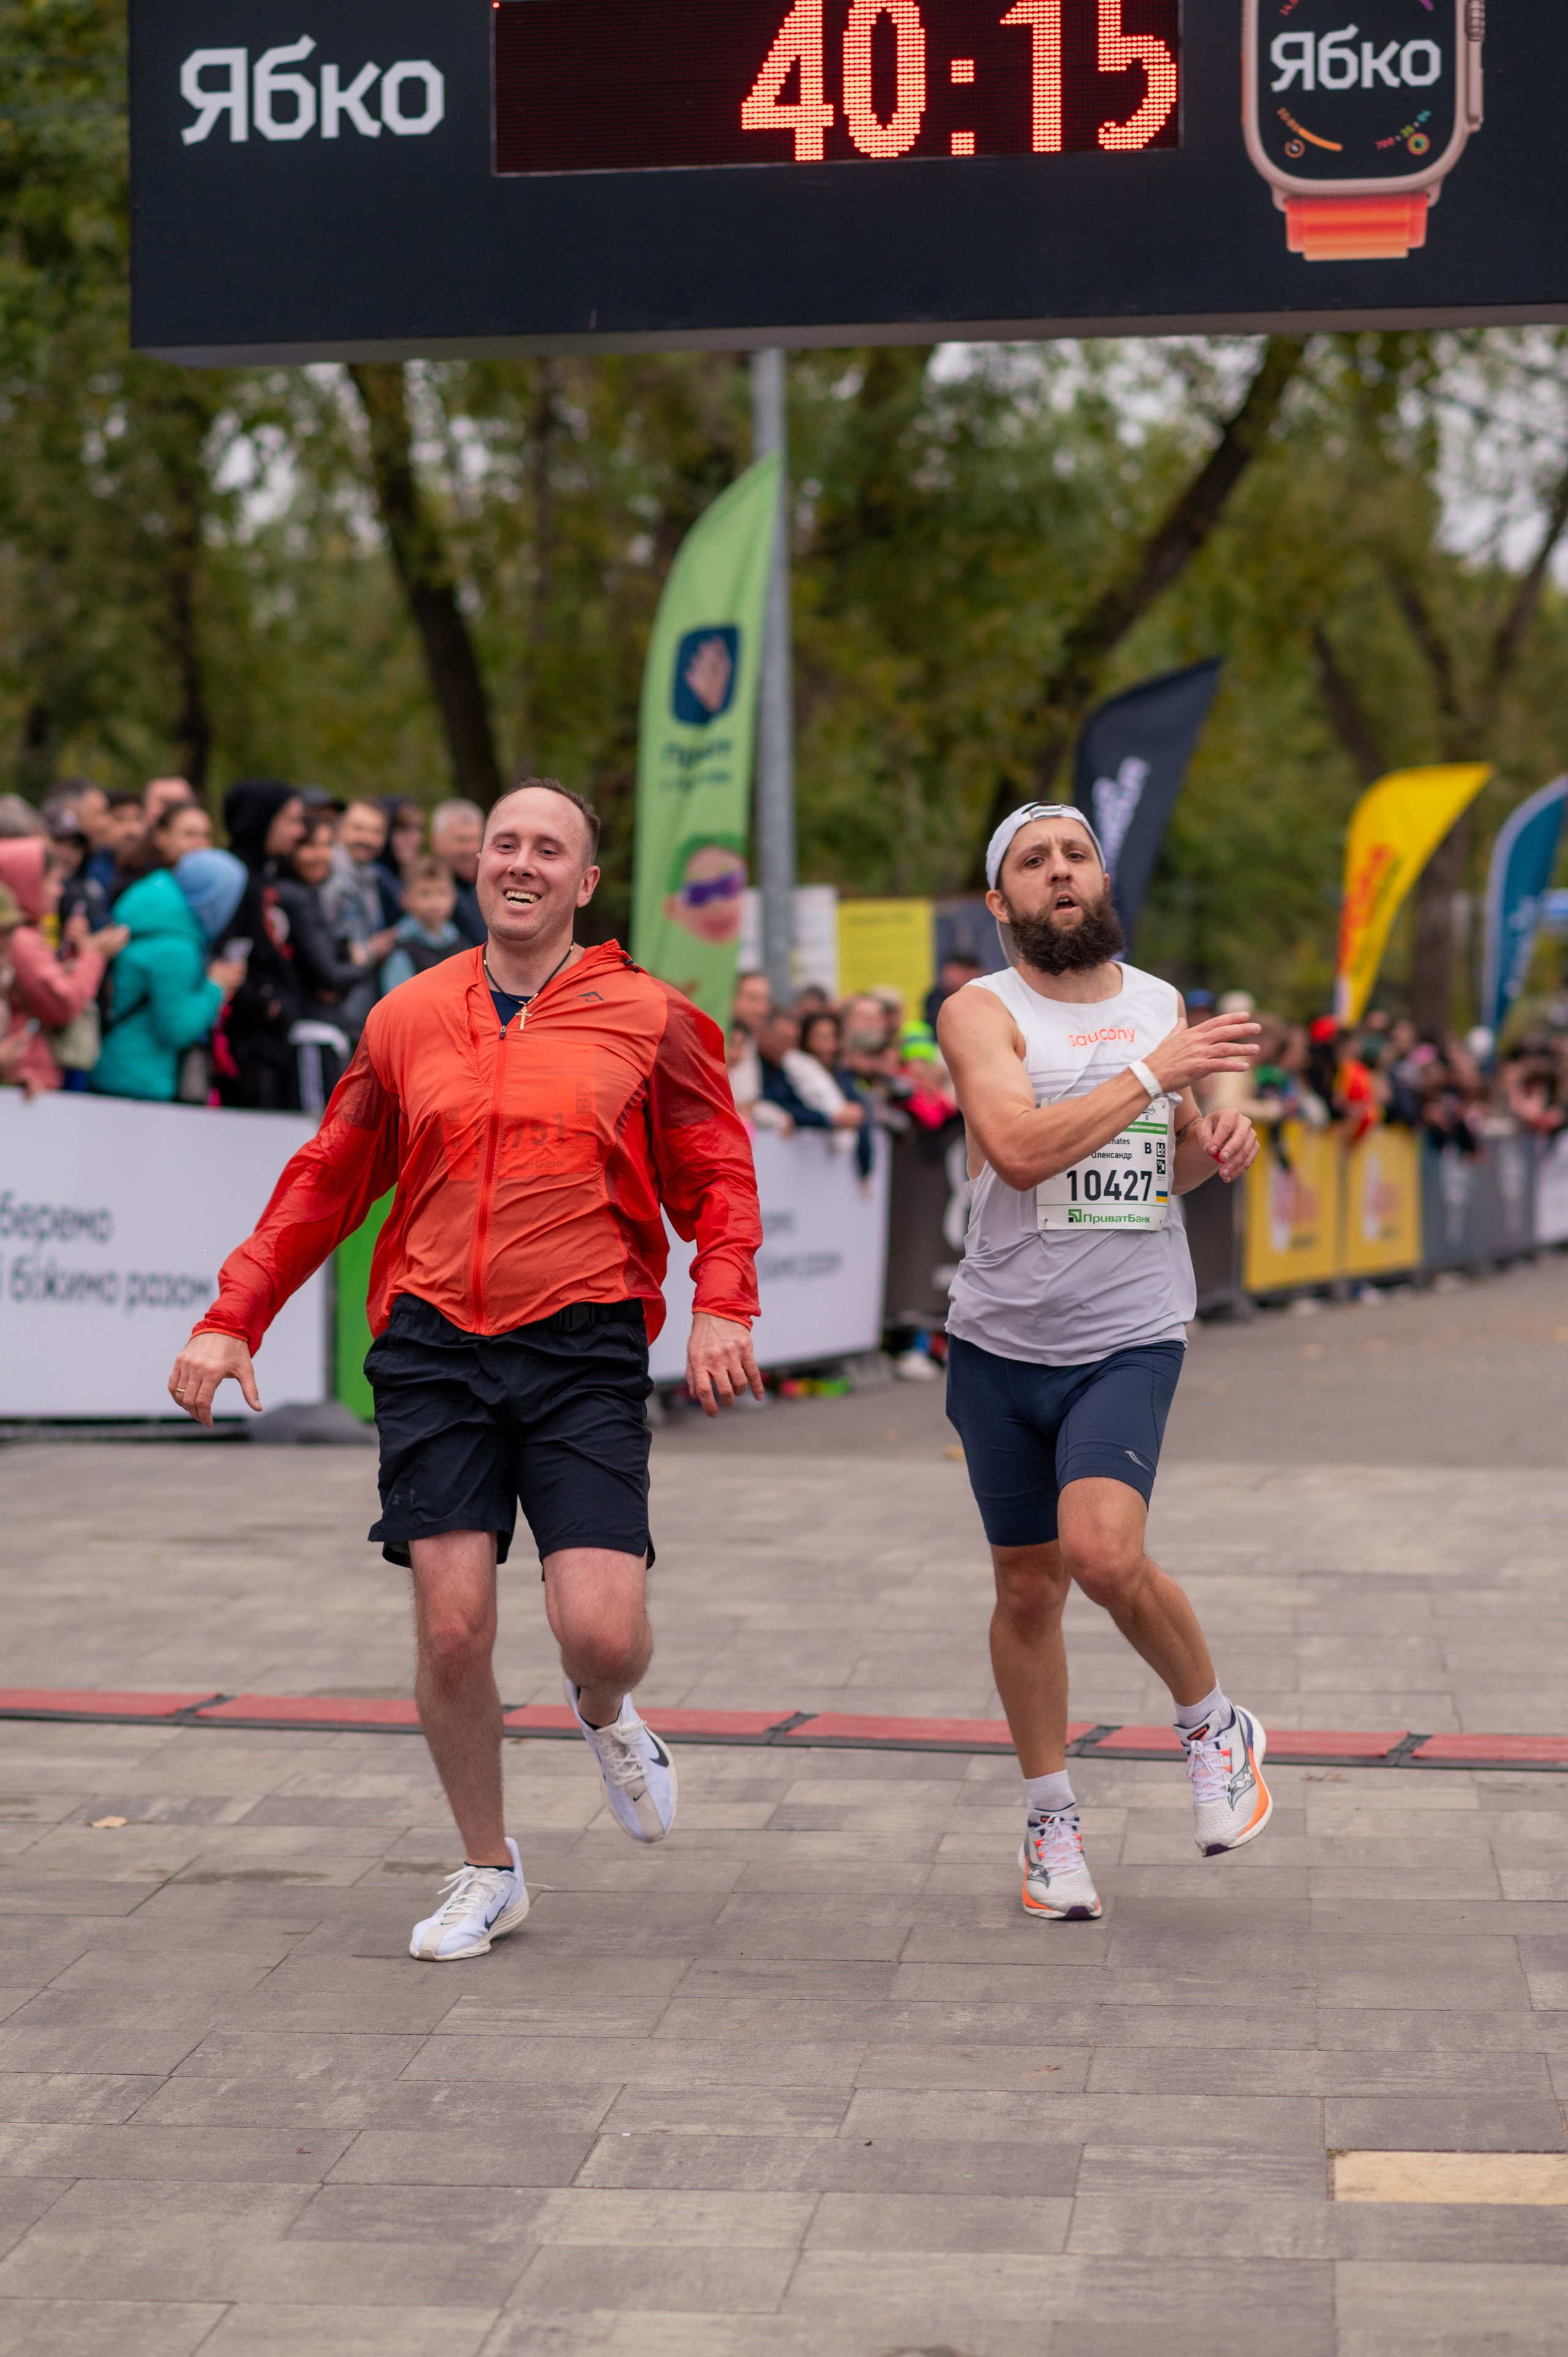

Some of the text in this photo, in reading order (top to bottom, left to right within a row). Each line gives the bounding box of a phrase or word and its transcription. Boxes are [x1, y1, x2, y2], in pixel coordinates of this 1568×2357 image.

[1270, 23, 1441, 93] Ябко
[180, 34, 445, 146] Ябко
[741, 0, 1177, 161] 40:15
[1069, 1028, 1136, 1047] saucony
[1091, 1152, 1133, 1161] Олександр
[1144, 1142, 1152, 1154] B
[1066, 1169, 1152, 1201] 10427
[1083, 1213, 1150, 1224] ПриватБанк
